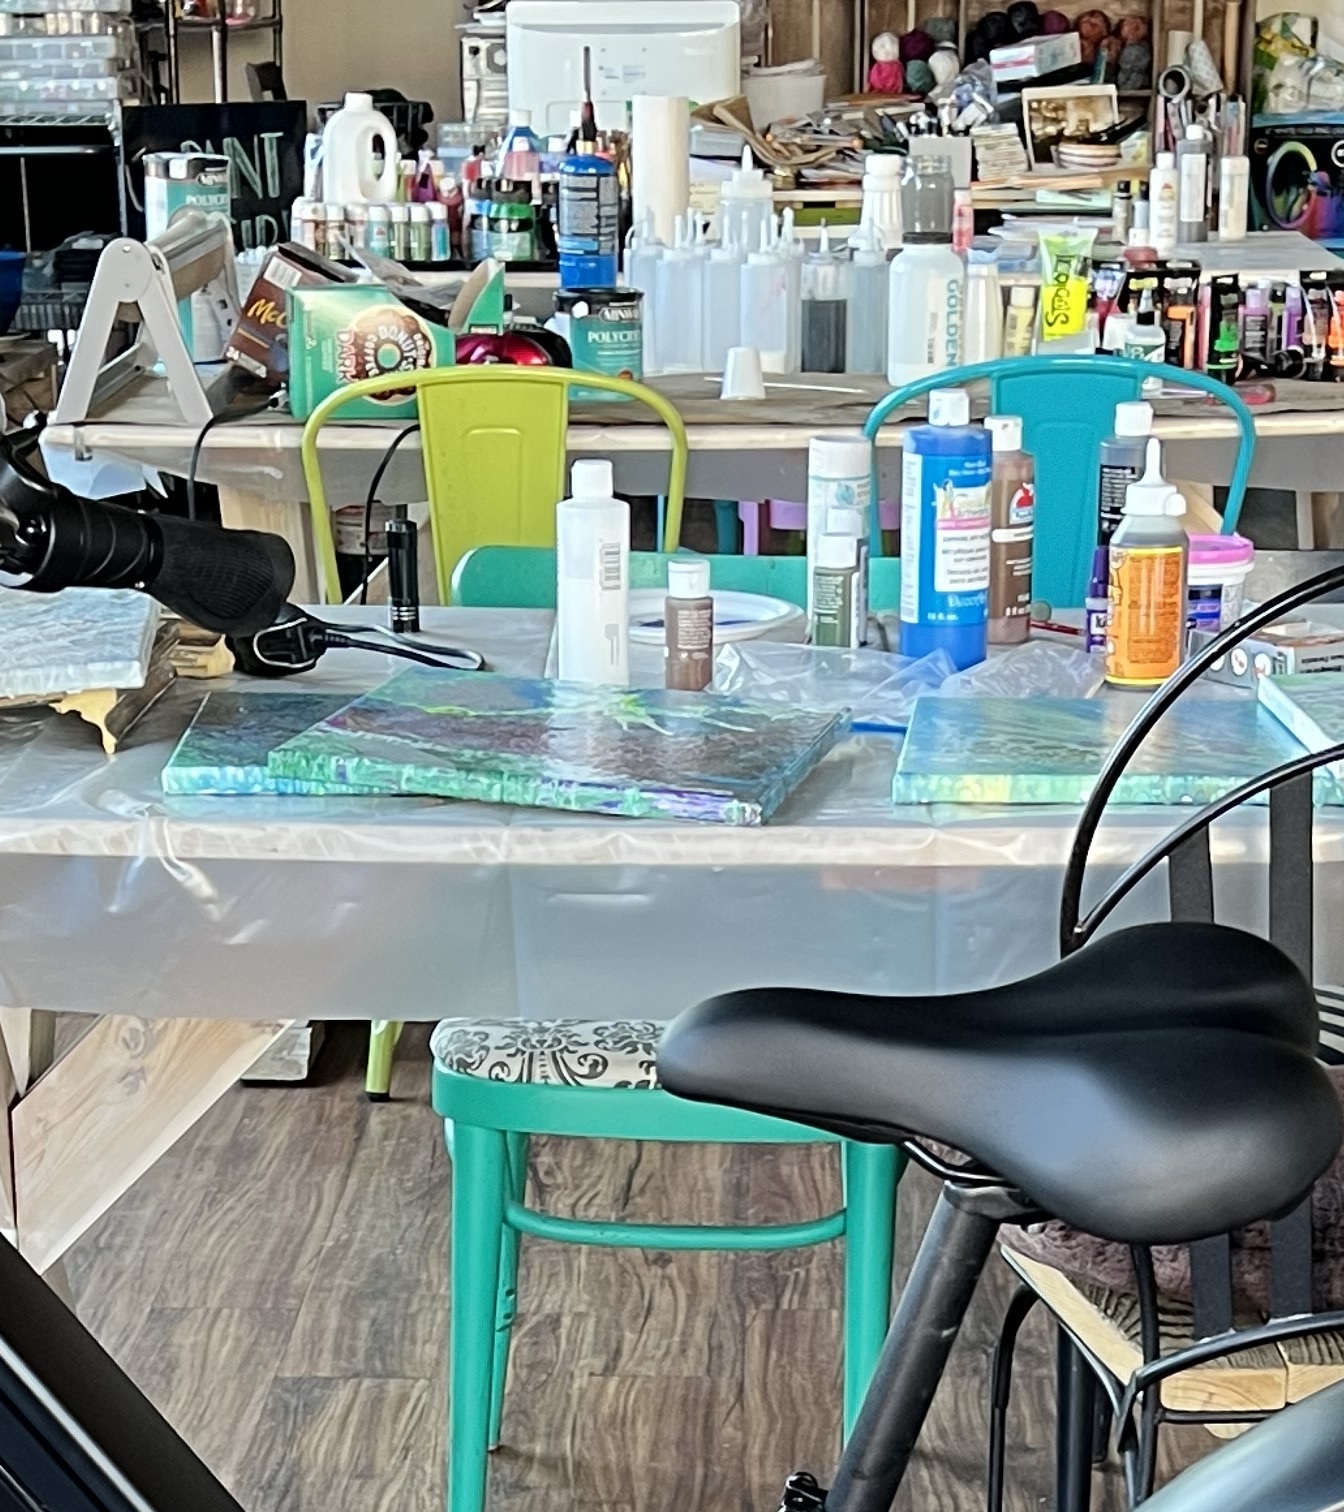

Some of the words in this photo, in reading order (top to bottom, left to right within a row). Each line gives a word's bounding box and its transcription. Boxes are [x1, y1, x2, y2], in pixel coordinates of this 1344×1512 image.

[946, 279, 960, 367] GOLDEN
[337, 330, 359, 383] DARK
[364, 334, 380, 377] COFFEE
